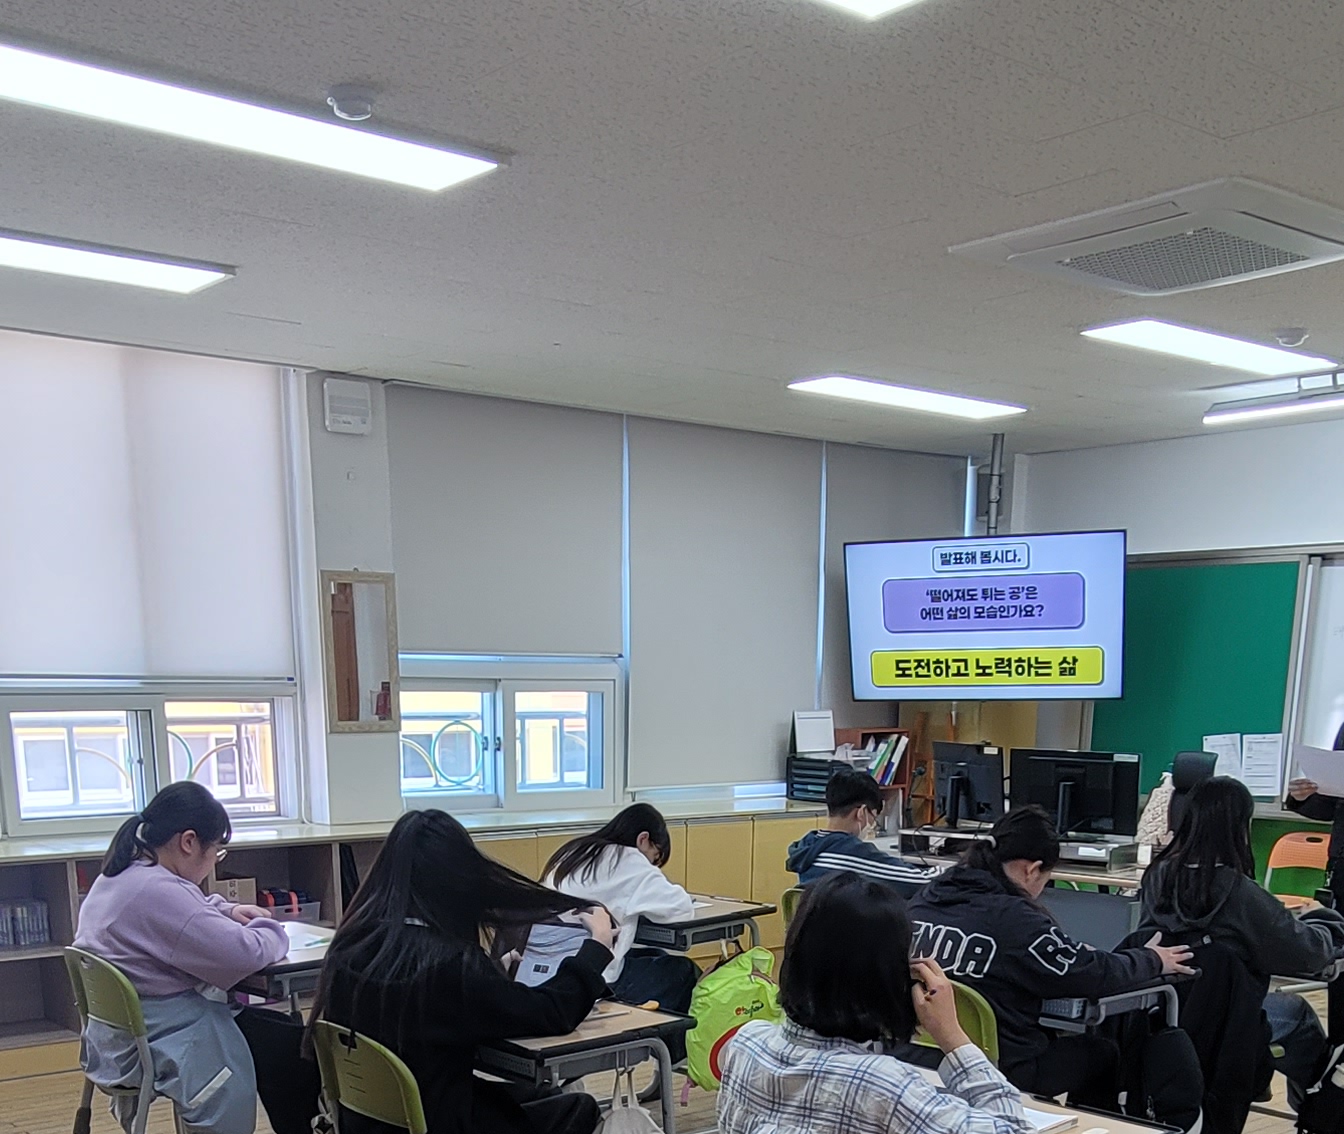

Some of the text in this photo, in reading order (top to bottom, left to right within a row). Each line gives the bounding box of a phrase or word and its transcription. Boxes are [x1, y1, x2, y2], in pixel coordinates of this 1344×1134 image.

[940, 549, 1021, 566] 발표해 봅시다.
[981, 587, 1005, 601] 튀는
[920, 604, 1044, 621] 어떤 삶의 모습인가요?
[895, 656, 1078, 679] 도전하고 노력하는 삶
